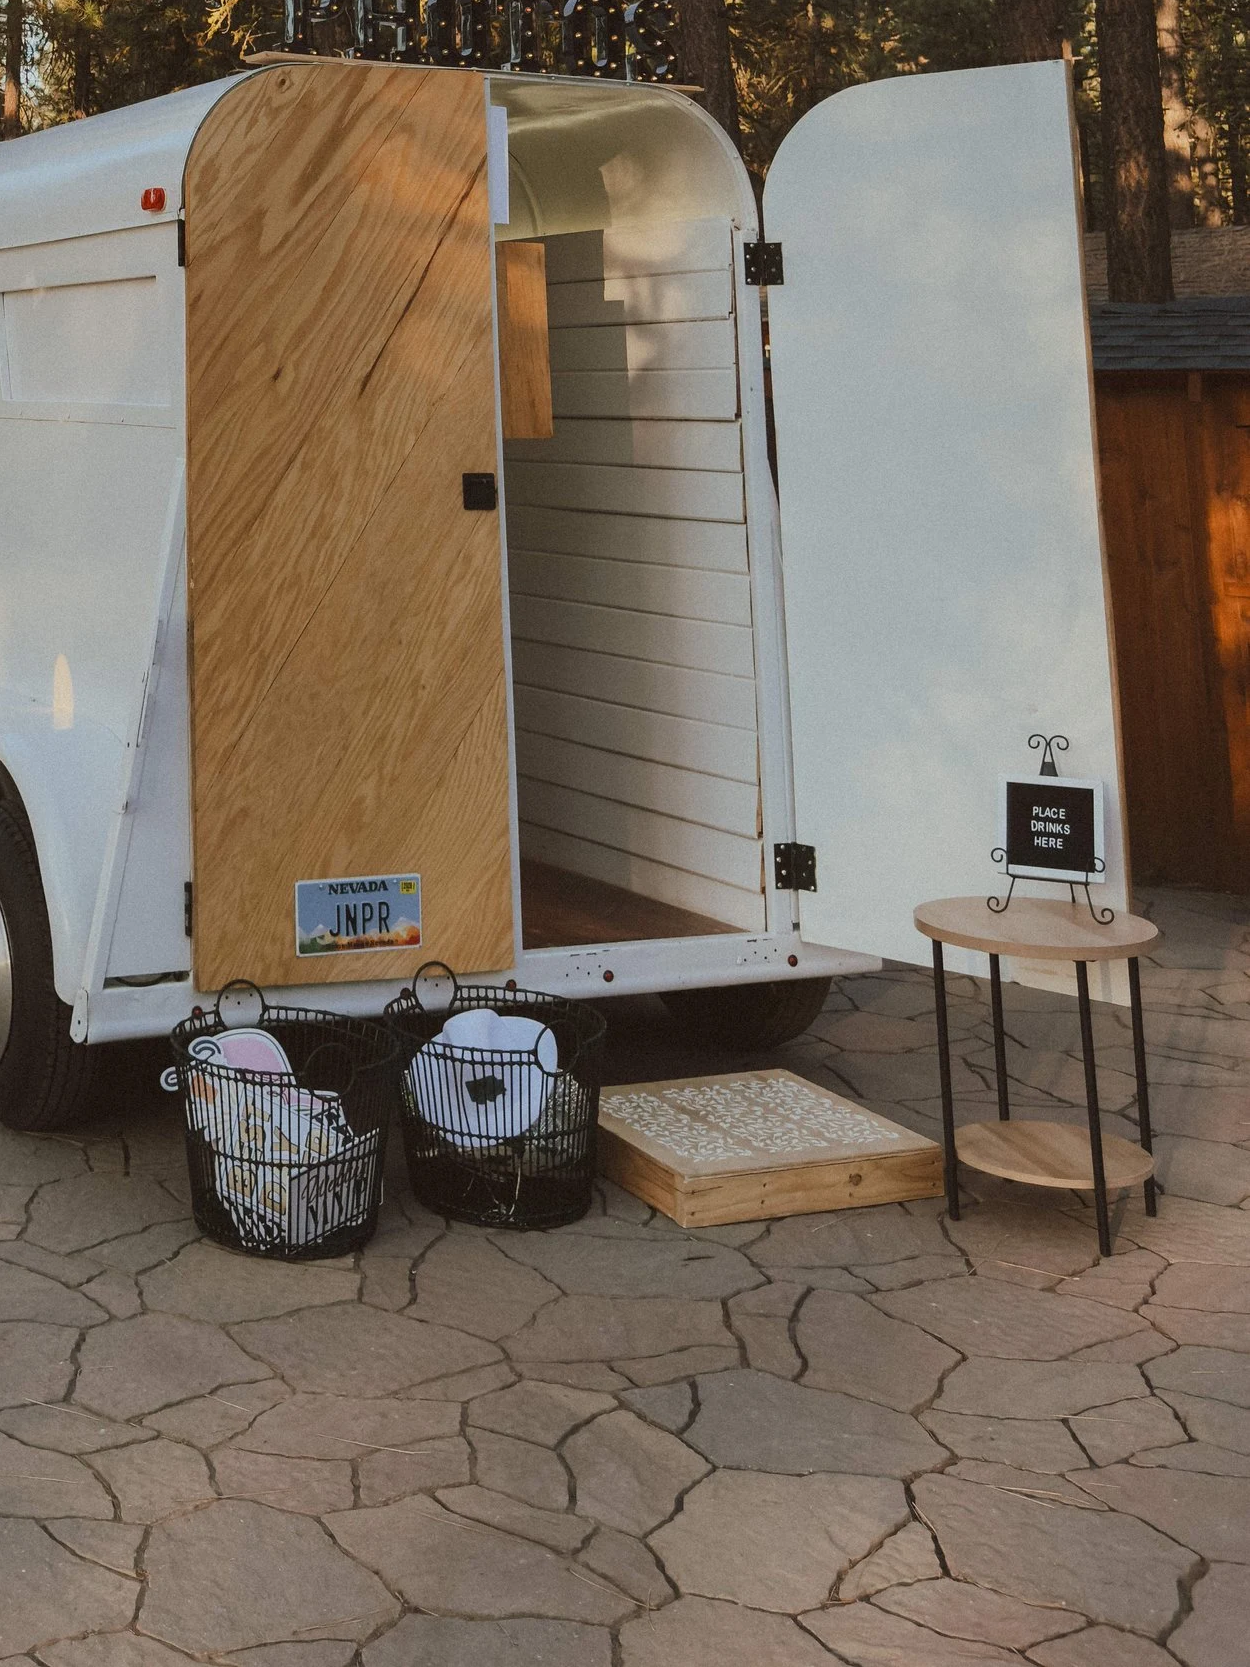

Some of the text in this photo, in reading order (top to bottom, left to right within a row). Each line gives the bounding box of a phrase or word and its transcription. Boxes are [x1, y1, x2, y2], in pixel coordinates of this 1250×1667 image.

[1032, 806, 1066, 820] PLACE
[1030, 820, 1071, 835] DRINKS
[1034, 836, 1064, 849] HERE
[328, 880, 389, 895] NEVADA
[329, 901, 391, 937] JNPR
